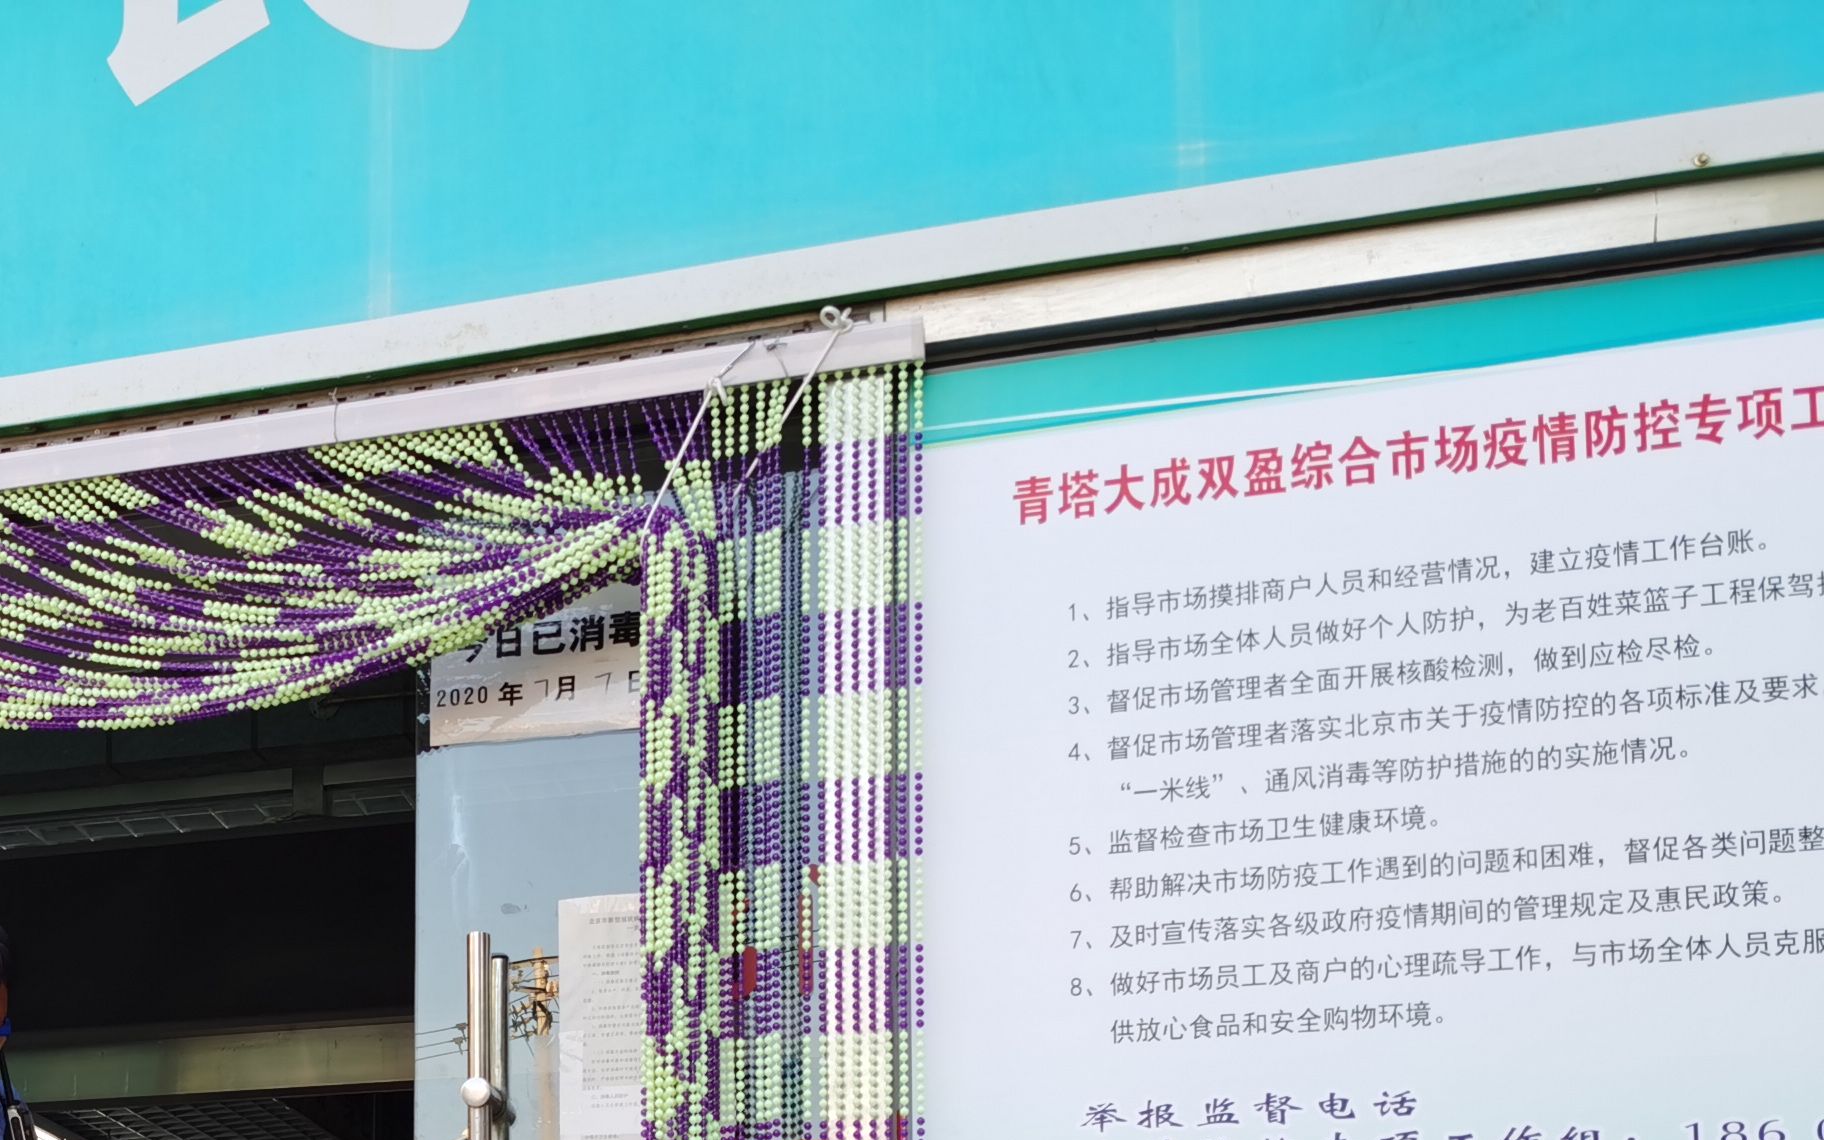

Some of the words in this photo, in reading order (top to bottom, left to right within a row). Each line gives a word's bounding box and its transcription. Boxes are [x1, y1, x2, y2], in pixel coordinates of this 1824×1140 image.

[1012, 384, 1824, 525] 青塔大成双盈综合市场疫情防控专项工
[1068, 527, 1766, 622] 1、指导市场摸排商户人员和经营情况，建立疫情工作台账。
[1068, 632, 1714, 716] 3、督促市场管理者全面开展核酸检测，做到应检尽检。
[1068, 804, 1441, 858] 5、监督检查市场卫生健康环境。
[1069, 879, 1783, 950] 7、及时宣传落实各级政府疫情期间的管理规定及惠民政策。
[1109, 1000, 1447, 1045] 供放心食品和安全购物环境。
[1079, 1089, 1419, 1132] 举报监督电话
